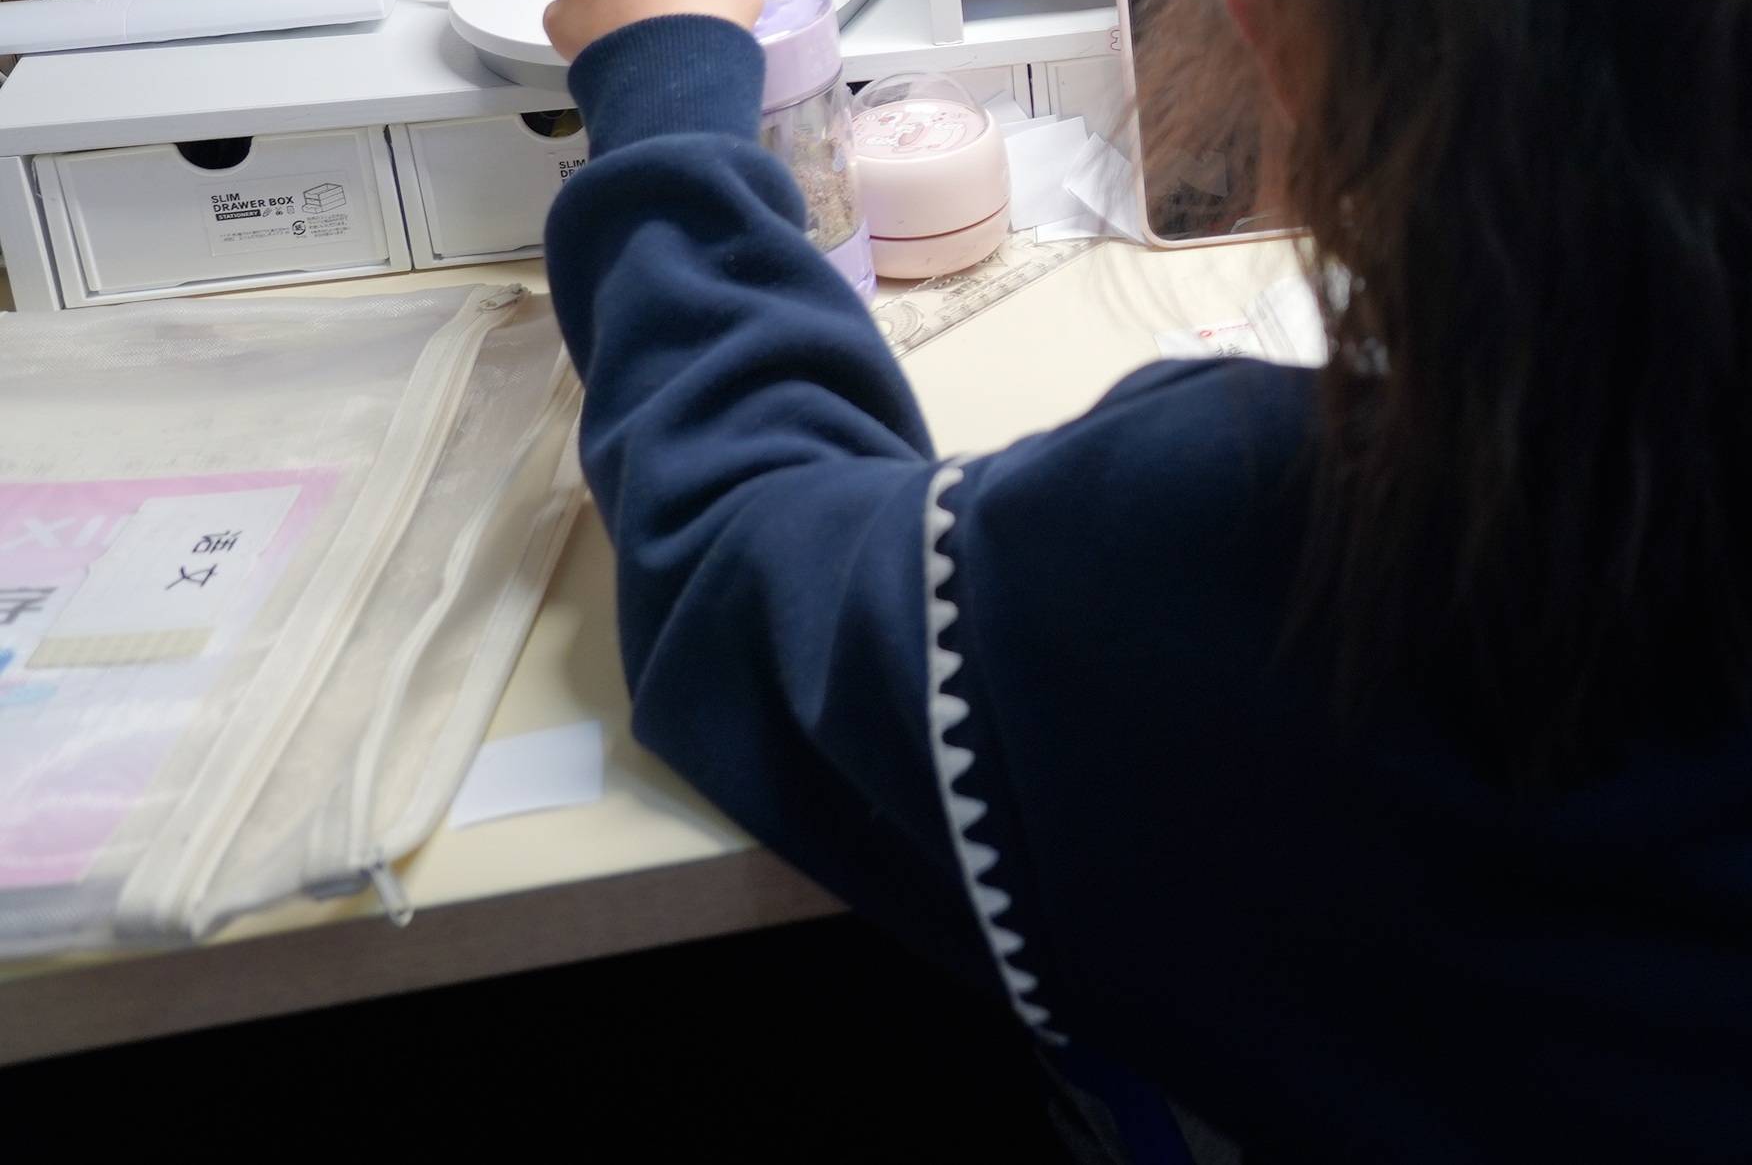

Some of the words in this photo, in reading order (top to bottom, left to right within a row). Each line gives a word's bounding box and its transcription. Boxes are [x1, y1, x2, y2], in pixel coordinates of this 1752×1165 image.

[211, 193, 240, 204] SLIM
[213, 199, 266, 213] DRAWER
[269, 196, 294, 207] BOX
